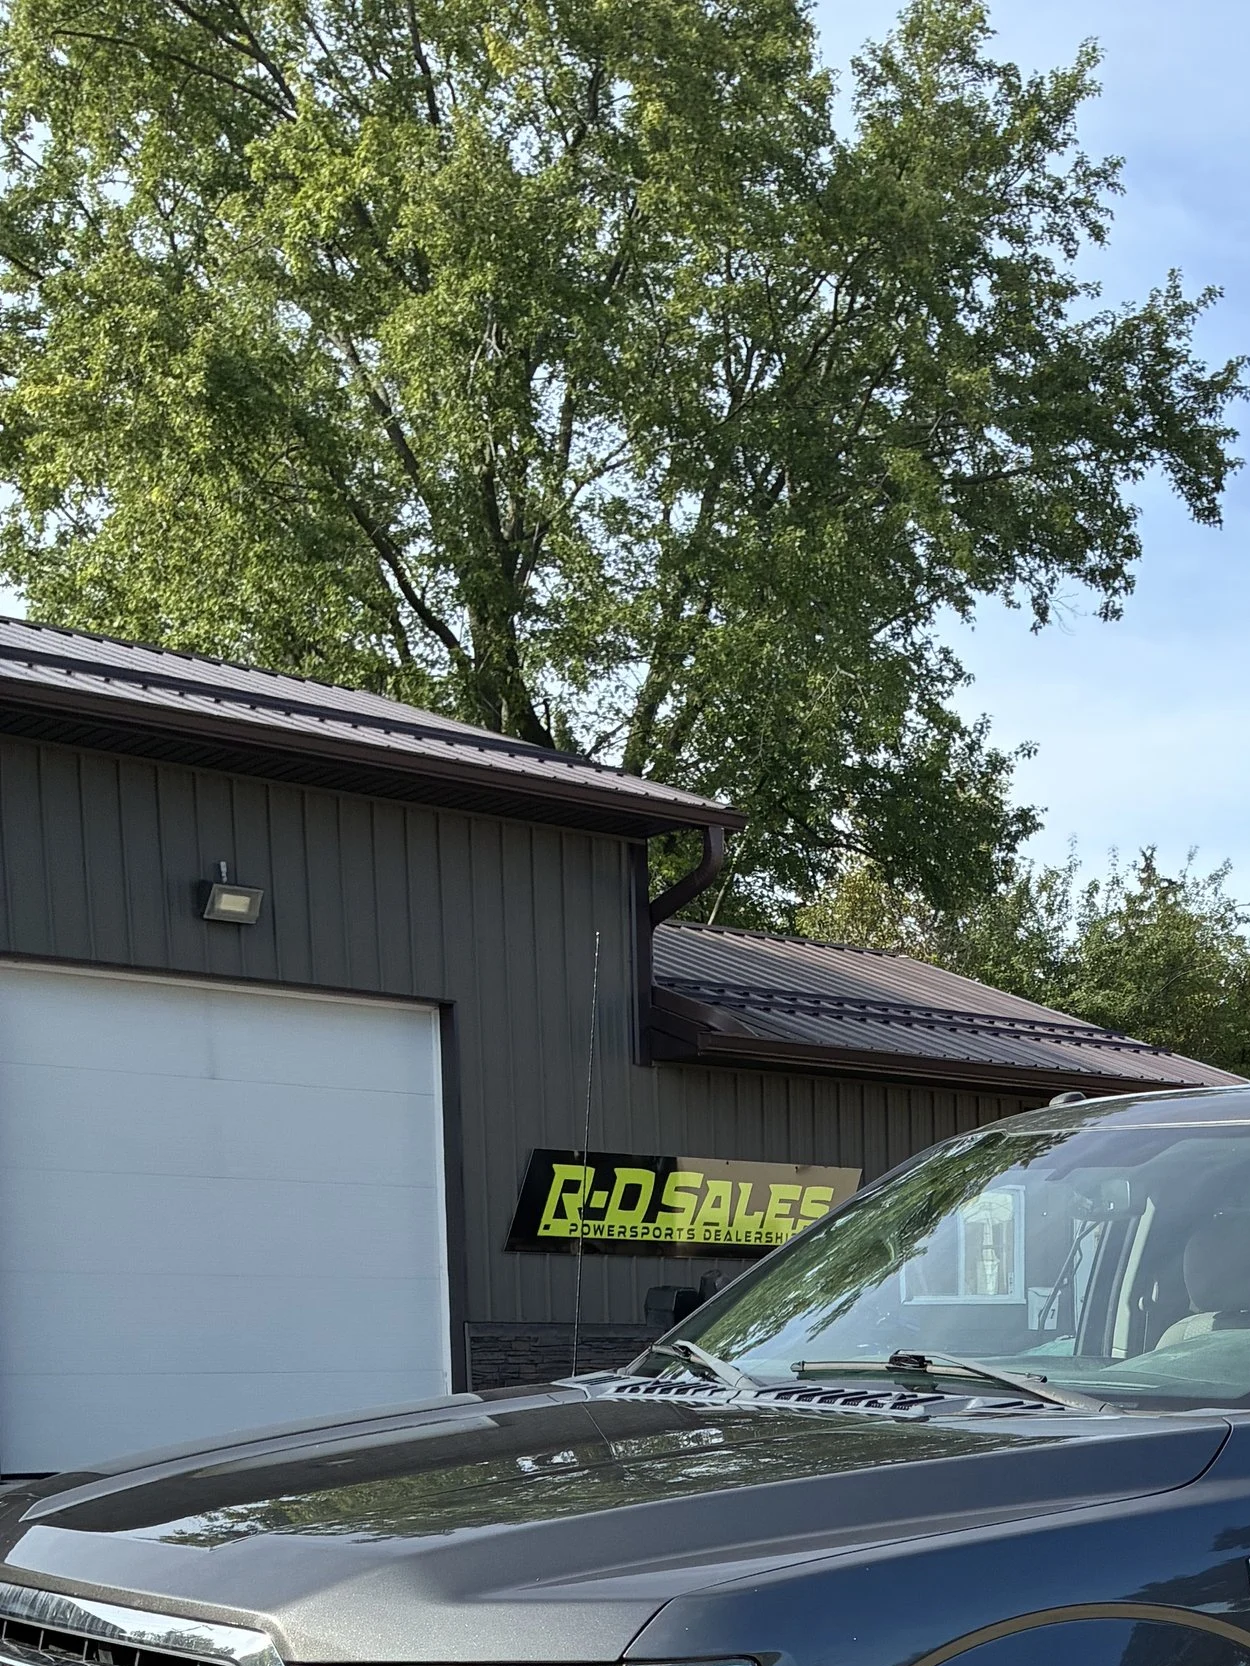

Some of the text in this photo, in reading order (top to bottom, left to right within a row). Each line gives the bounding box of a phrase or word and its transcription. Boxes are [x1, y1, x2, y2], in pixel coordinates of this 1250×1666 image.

[541, 1163, 835, 1229] R-D SALES
[569, 1222, 696, 1241] POWERSPORTS
